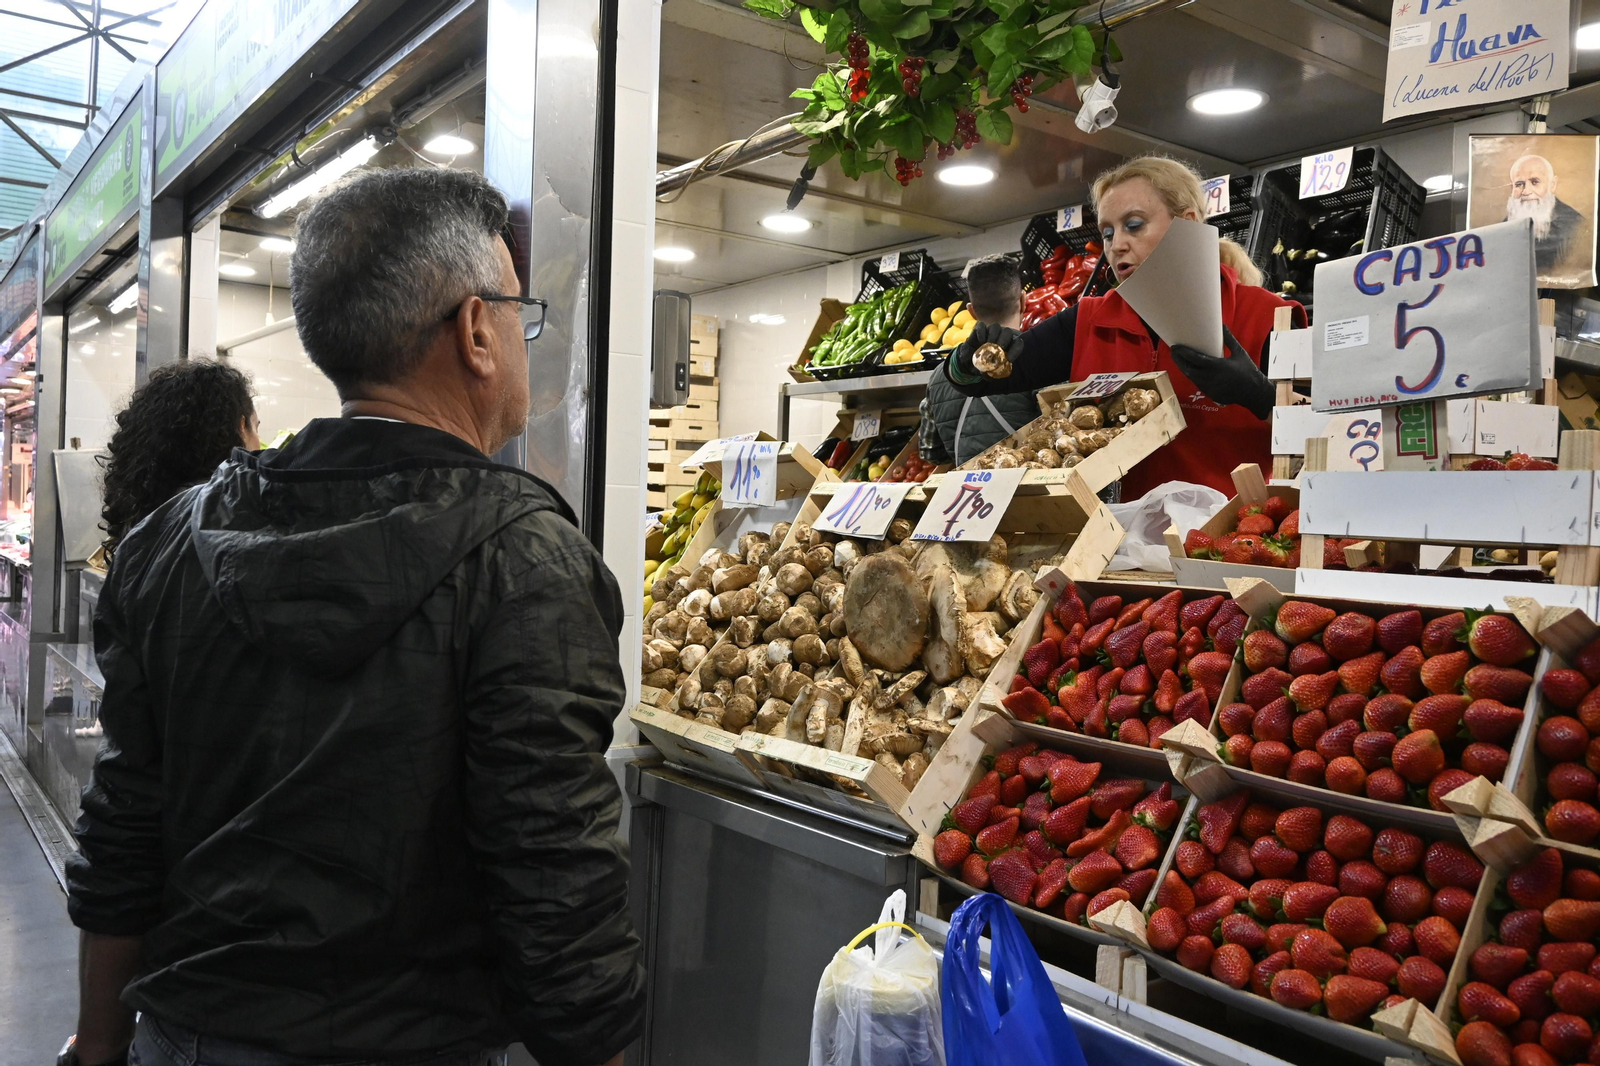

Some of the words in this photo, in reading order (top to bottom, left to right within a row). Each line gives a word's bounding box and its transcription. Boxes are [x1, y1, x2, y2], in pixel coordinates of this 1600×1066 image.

[1468, 61, 1501, 93] del
[1354, 234, 1485, 295] CAJA
[1394, 283, 1445, 394] 5
